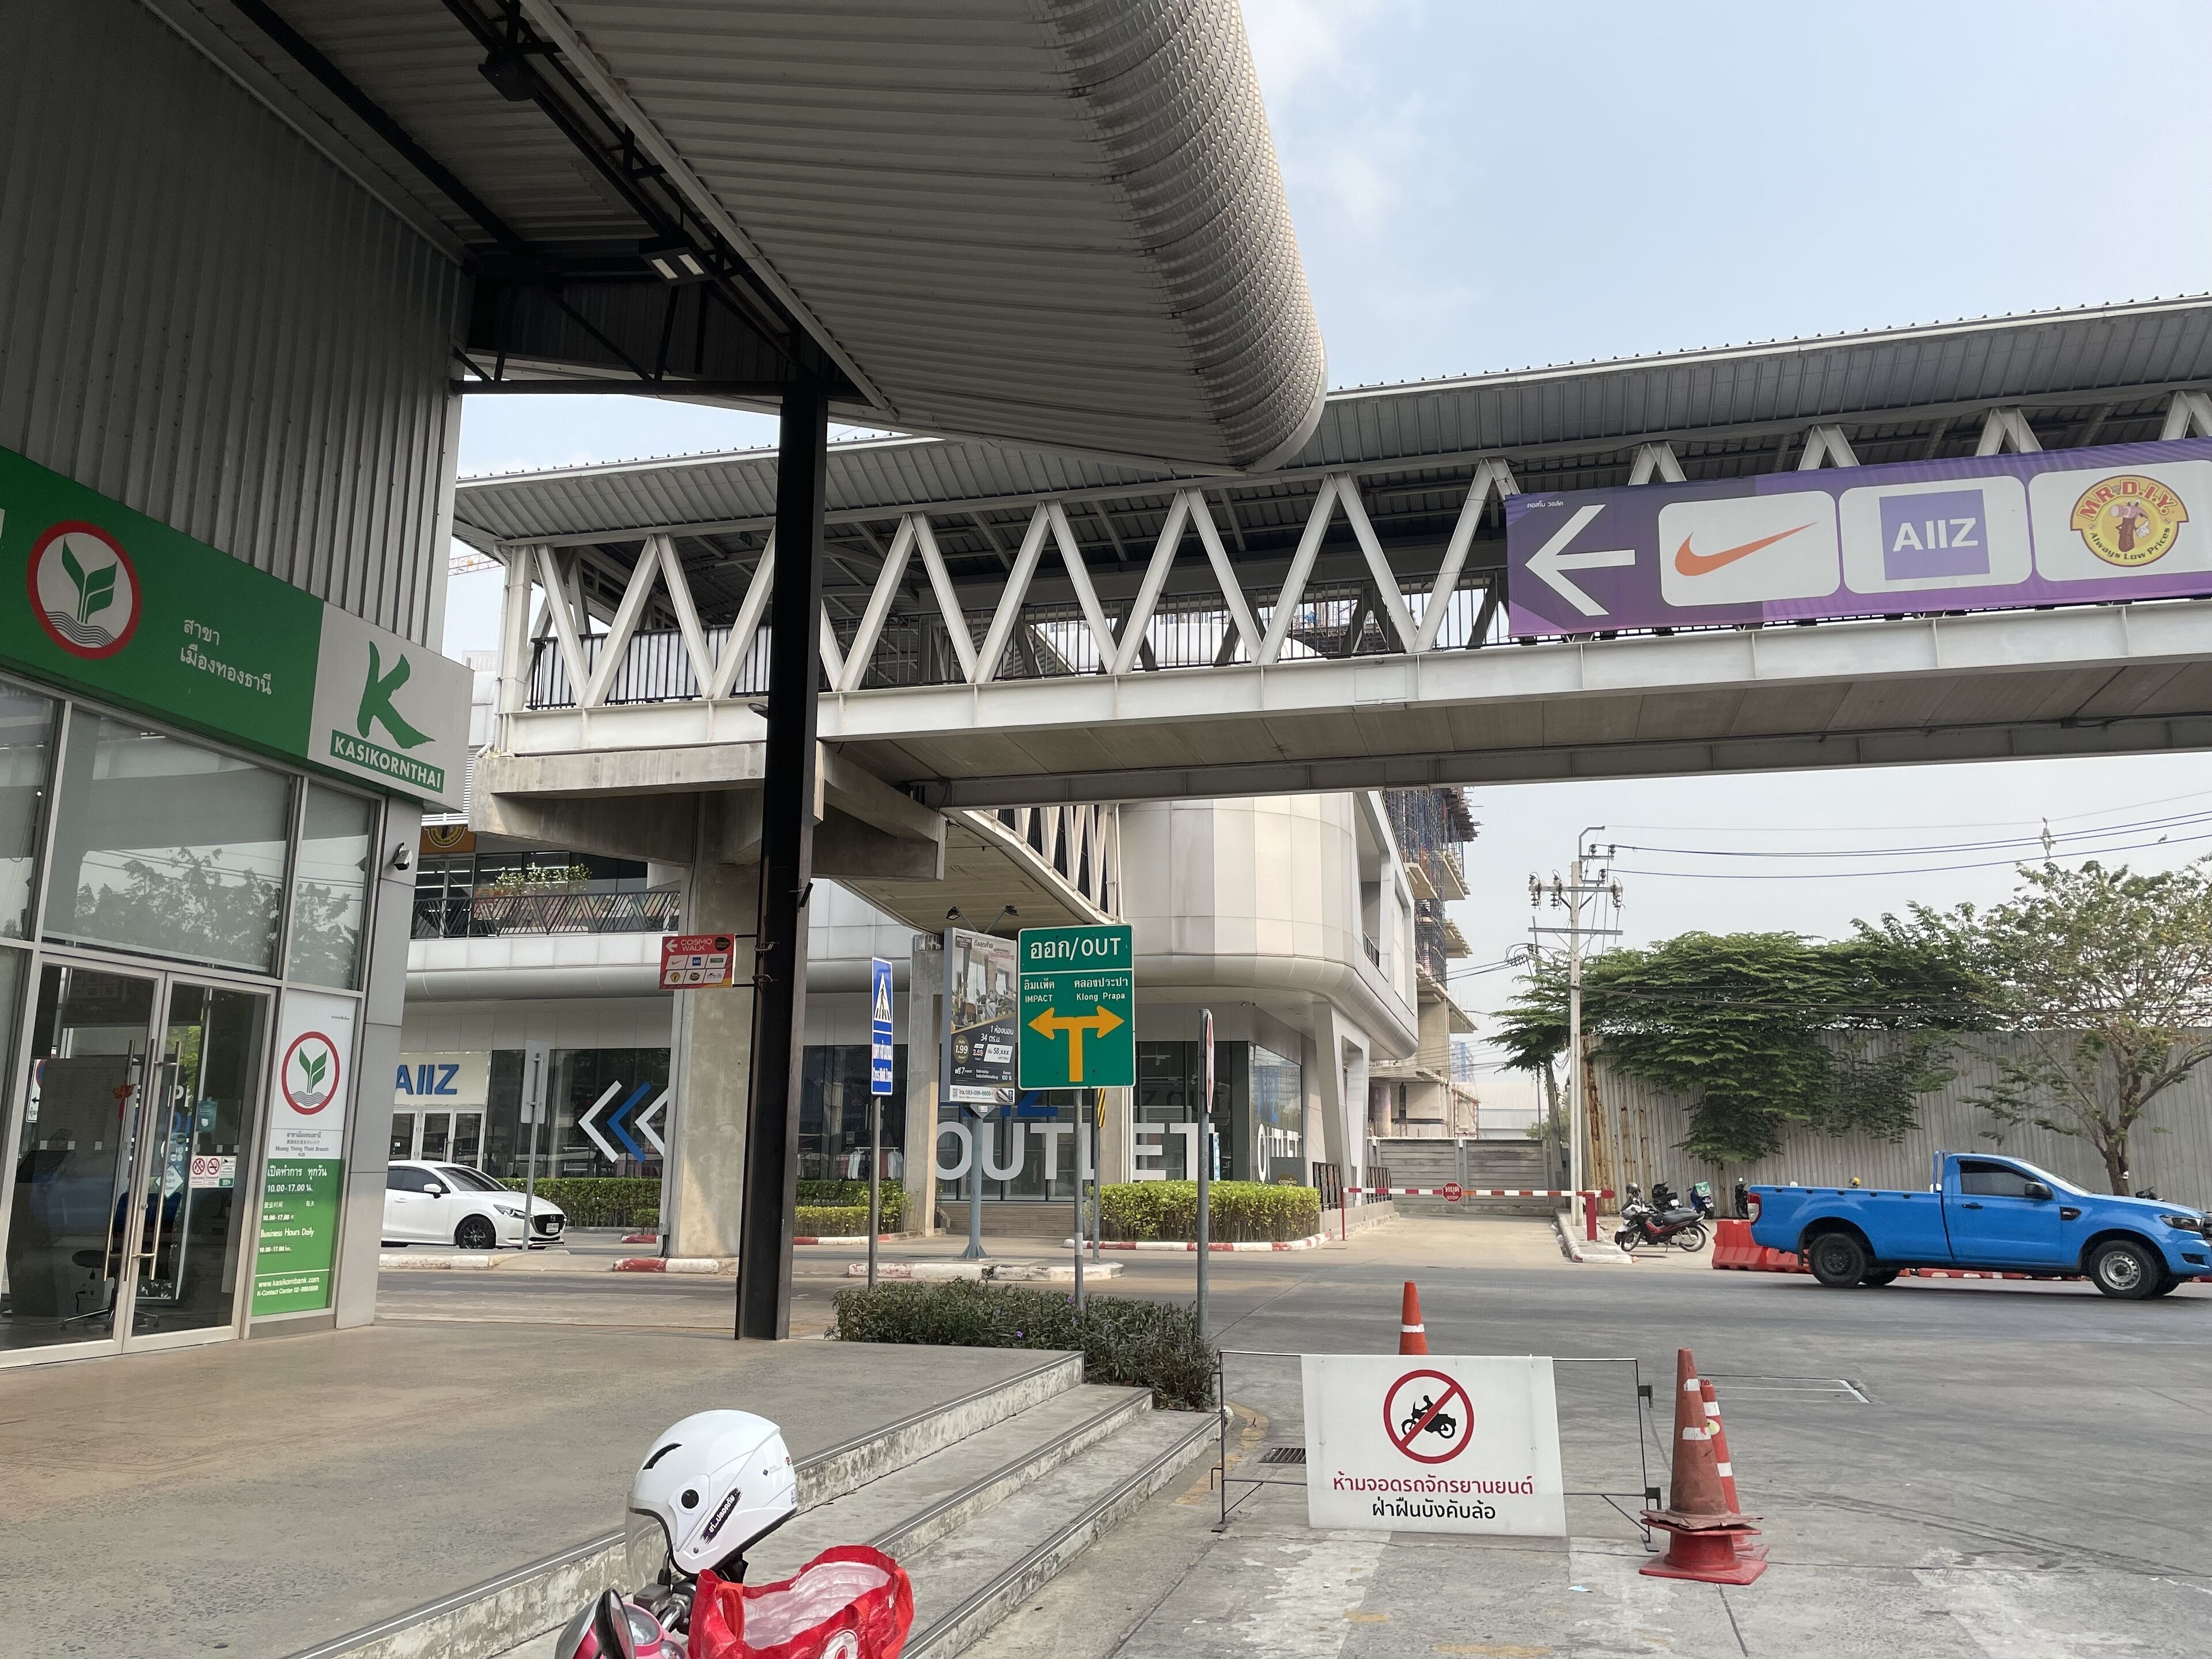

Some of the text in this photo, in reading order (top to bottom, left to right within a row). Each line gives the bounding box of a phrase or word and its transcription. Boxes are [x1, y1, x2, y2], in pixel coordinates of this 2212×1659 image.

[2090, 531, 2121, 559] Always
[2124, 551, 2146, 560] Low
[2147, 527, 2171, 555] Prices
[183, 619, 221, 646] สาขา
[180, 643, 272, 695] เมืองทองธานี
[335, 736, 442, 789] KASIKORNTHAI
[680, 938, 713, 946] COSMO
[1074, 976, 1128, 988] คลองประปา
[1025, 992, 1126, 1003] IMPACT Klong Prapa
[994, 1024, 1014, 1035] ห้องนอน
[980, 1033, 988, 1041] 34
[955, 1044, 968, 1054] 1.99
[267, 1164, 327, 1181] เปิดทำการ ทุกวัน
[267, 1184, 305, 1192] 10.00-17.00
[1445, 1185, 1460, 1195] หยุด
[260, 1226, 315, 1238] Business Hours Daily
[258, 1277, 320, 1289] www.kasikornbank.com
[257, 1288, 279, 1297] K-Contact
[279, 1287, 294, 1295] Center
[1333, 1470, 1533, 1495] ห้ามจอดรถจักรยานยนต์
[1372, 1496, 1497, 1520] ฝ่าฝืนบังคับล้อ
